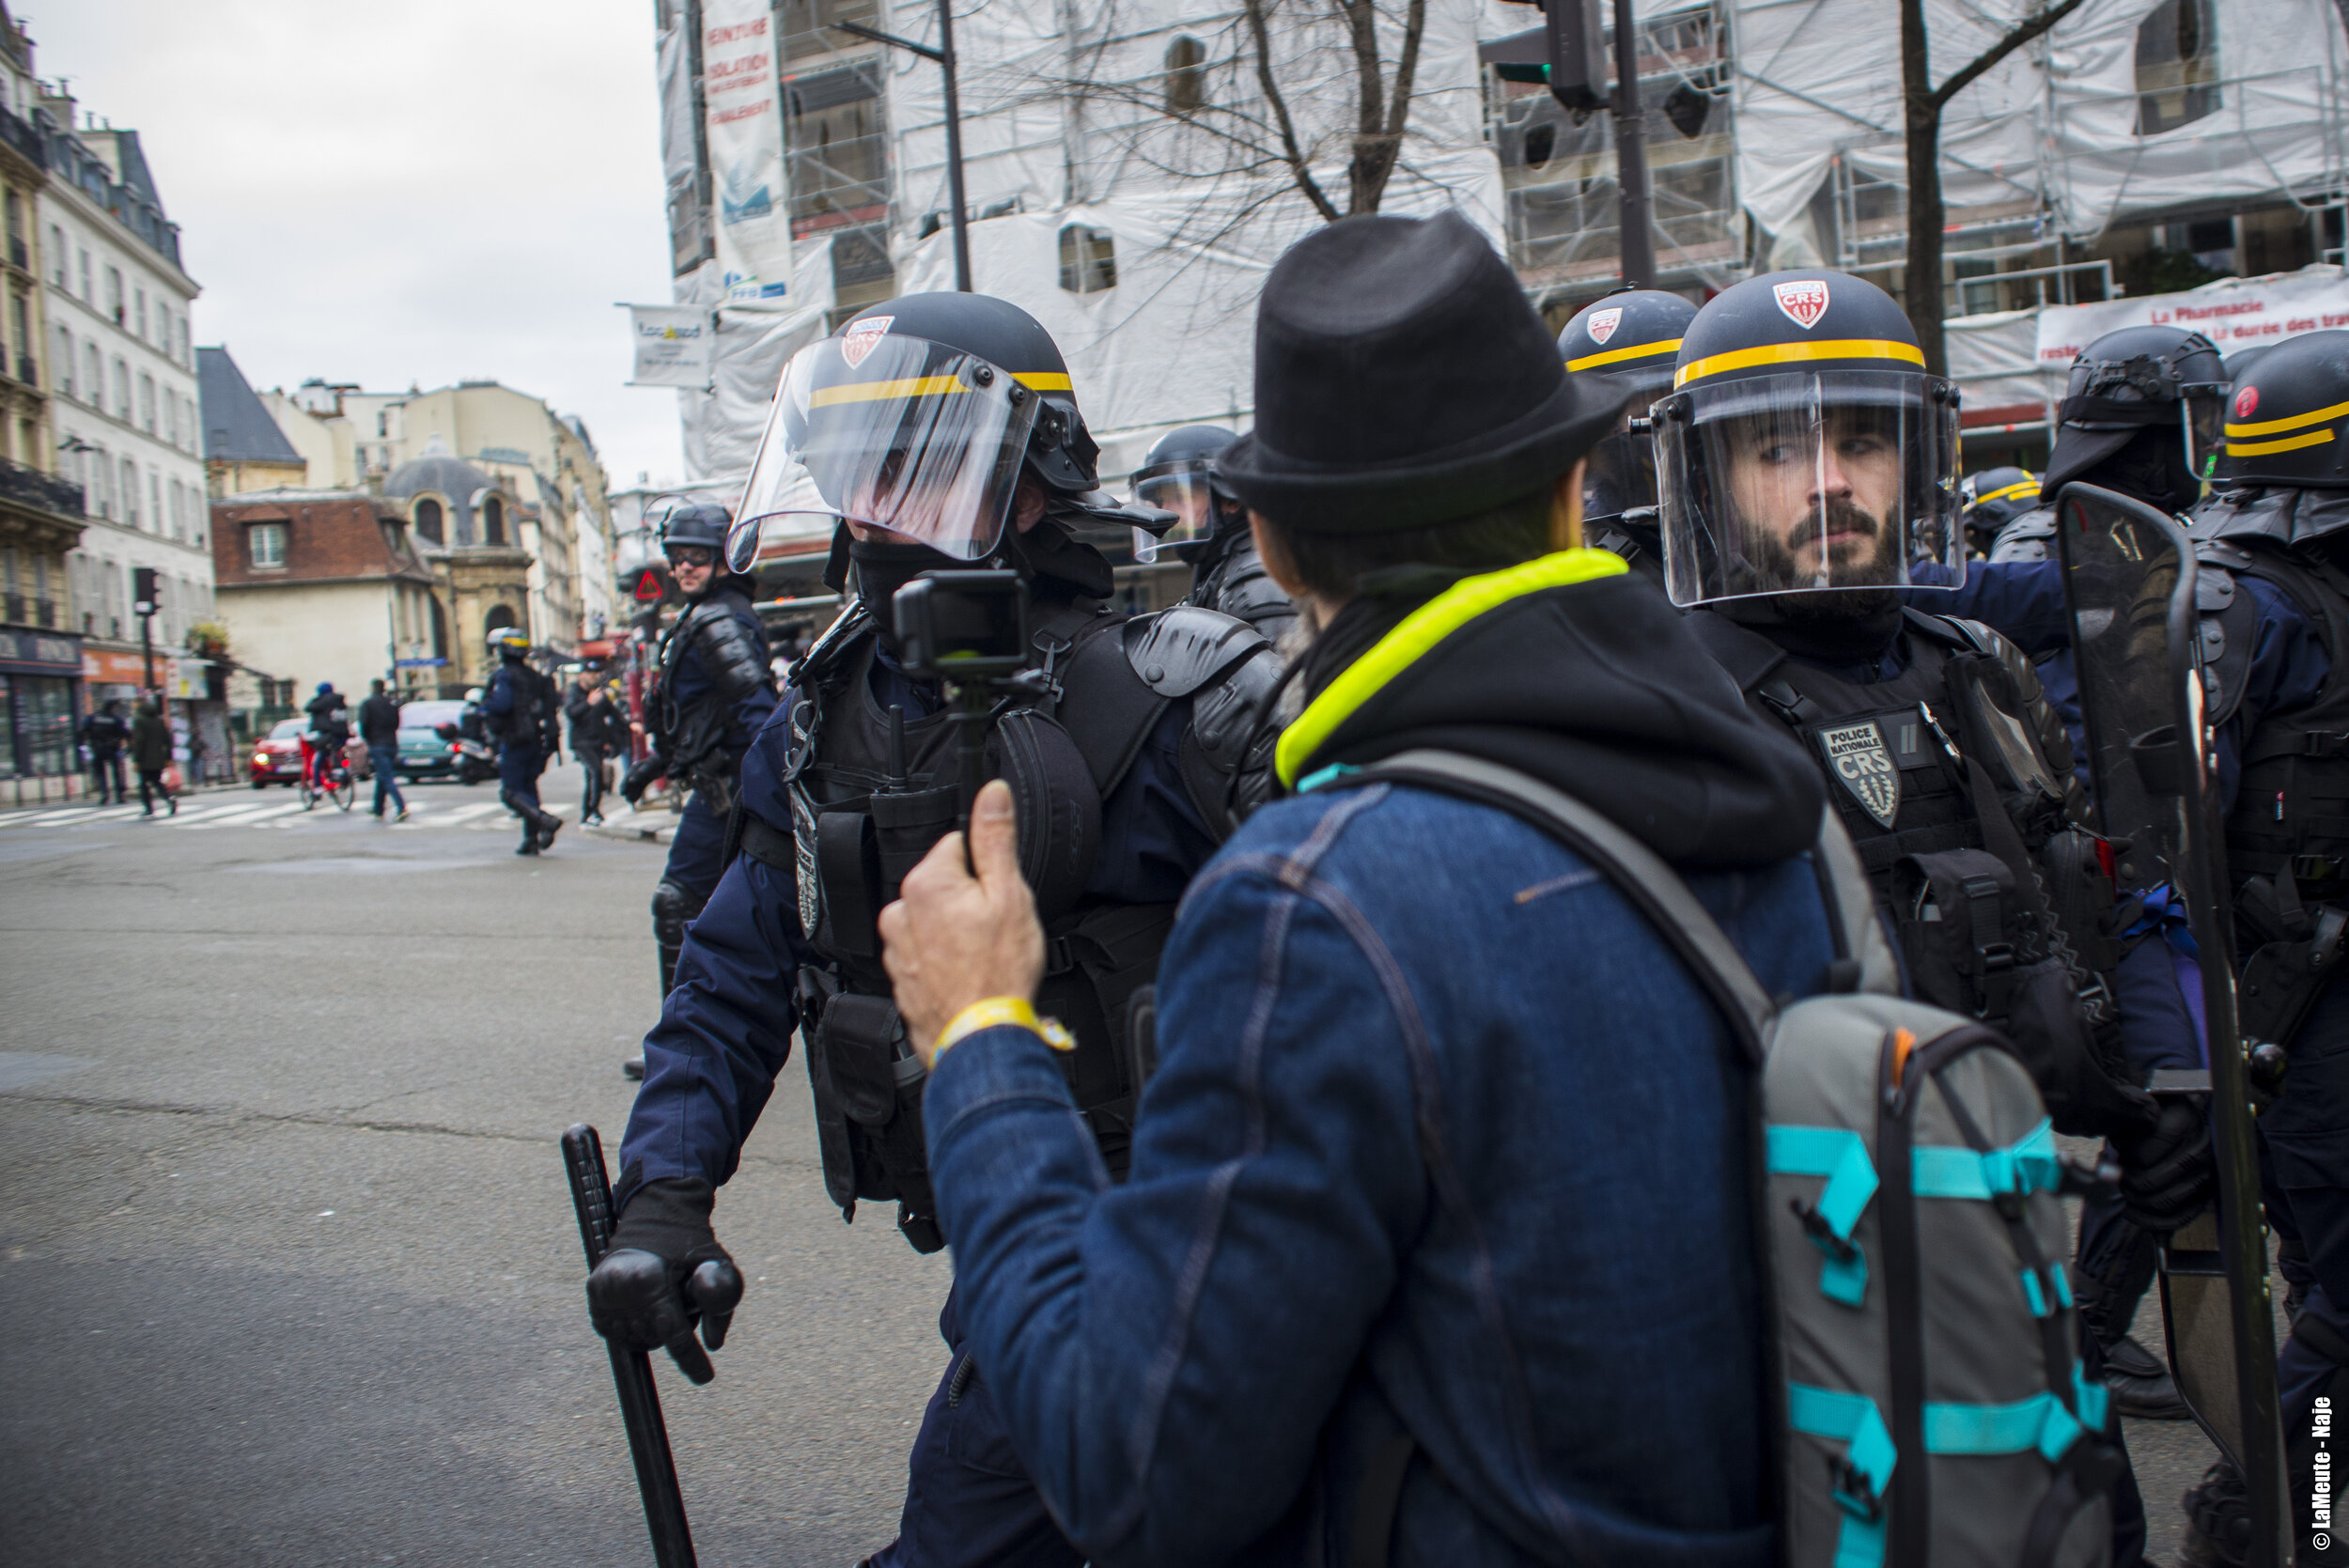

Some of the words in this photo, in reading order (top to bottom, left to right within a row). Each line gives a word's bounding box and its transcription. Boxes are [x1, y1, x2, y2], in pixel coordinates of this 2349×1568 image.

[1782, 292, 1823, 306] CRS
[2152, 311, 2170, 324] La
[2175, 301, 2264, 321] Pharmacie
[2287, 318, 2316, 333] des
[1830, 727, 1872, 743] POLICE
[1830, 737, 1880, 754] NATIONALE
[1837, 750, 1891, 779] CRS
